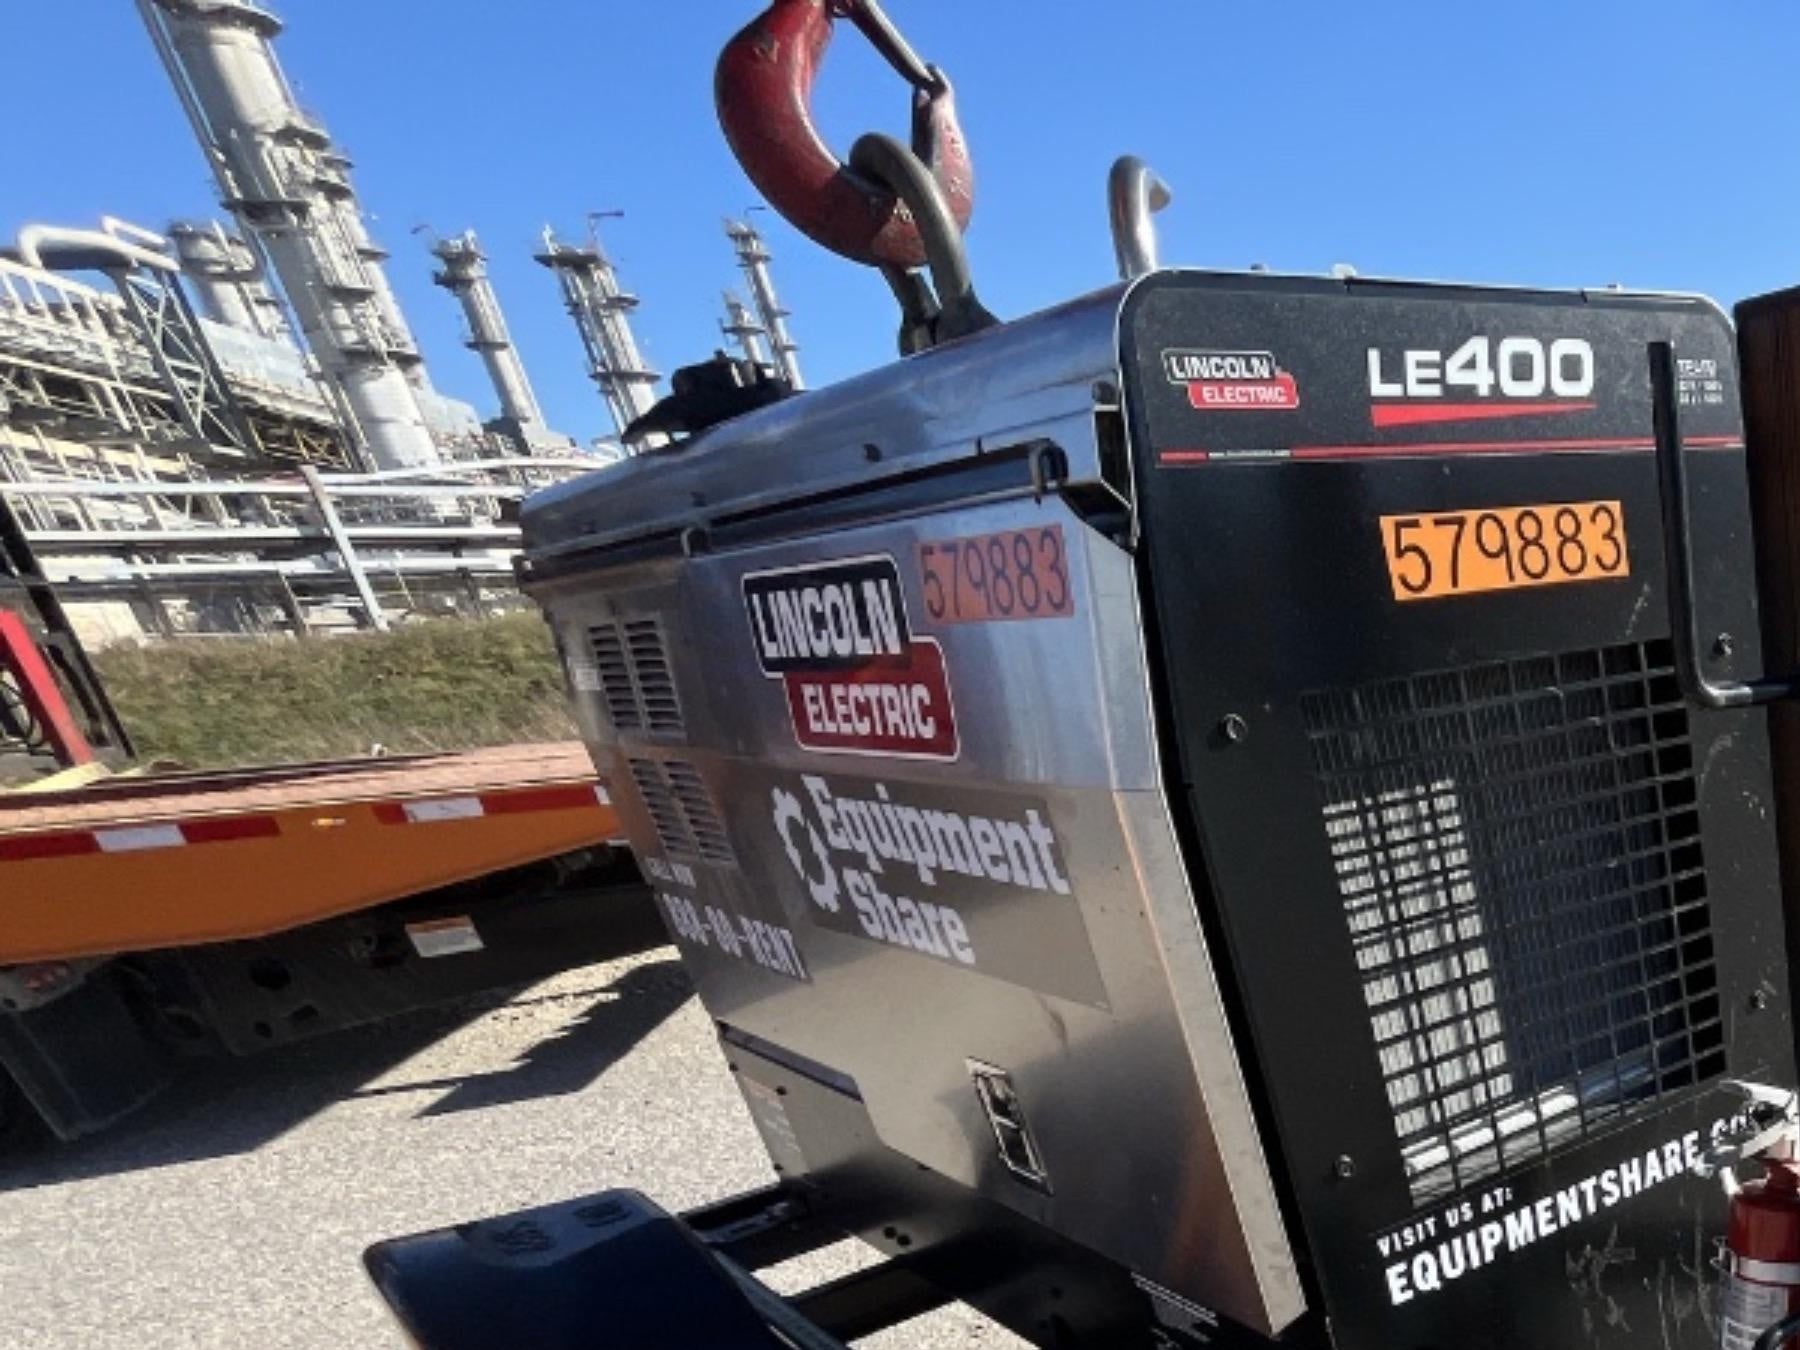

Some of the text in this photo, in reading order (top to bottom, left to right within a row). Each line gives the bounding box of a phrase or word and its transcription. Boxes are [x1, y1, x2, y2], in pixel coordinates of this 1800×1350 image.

[1170, 356, 1271, 379] LINCOLN
[1202, 386, 1288, 403] ELECTRIC
[1367, 334, 1595, 397] LE400
[920, 527, 1068, 619] 579883
[1393, 503, 1622, 594] 579883
[752, 578, 901, 659] LINCOLN
[800, 682, 936, 740] ELECTRIC
[801, 773, 1072, 895] Equipment
[842, 867, 976, 965] Share
[1376, 1185, 1513, 1258] VISIT US AT:
